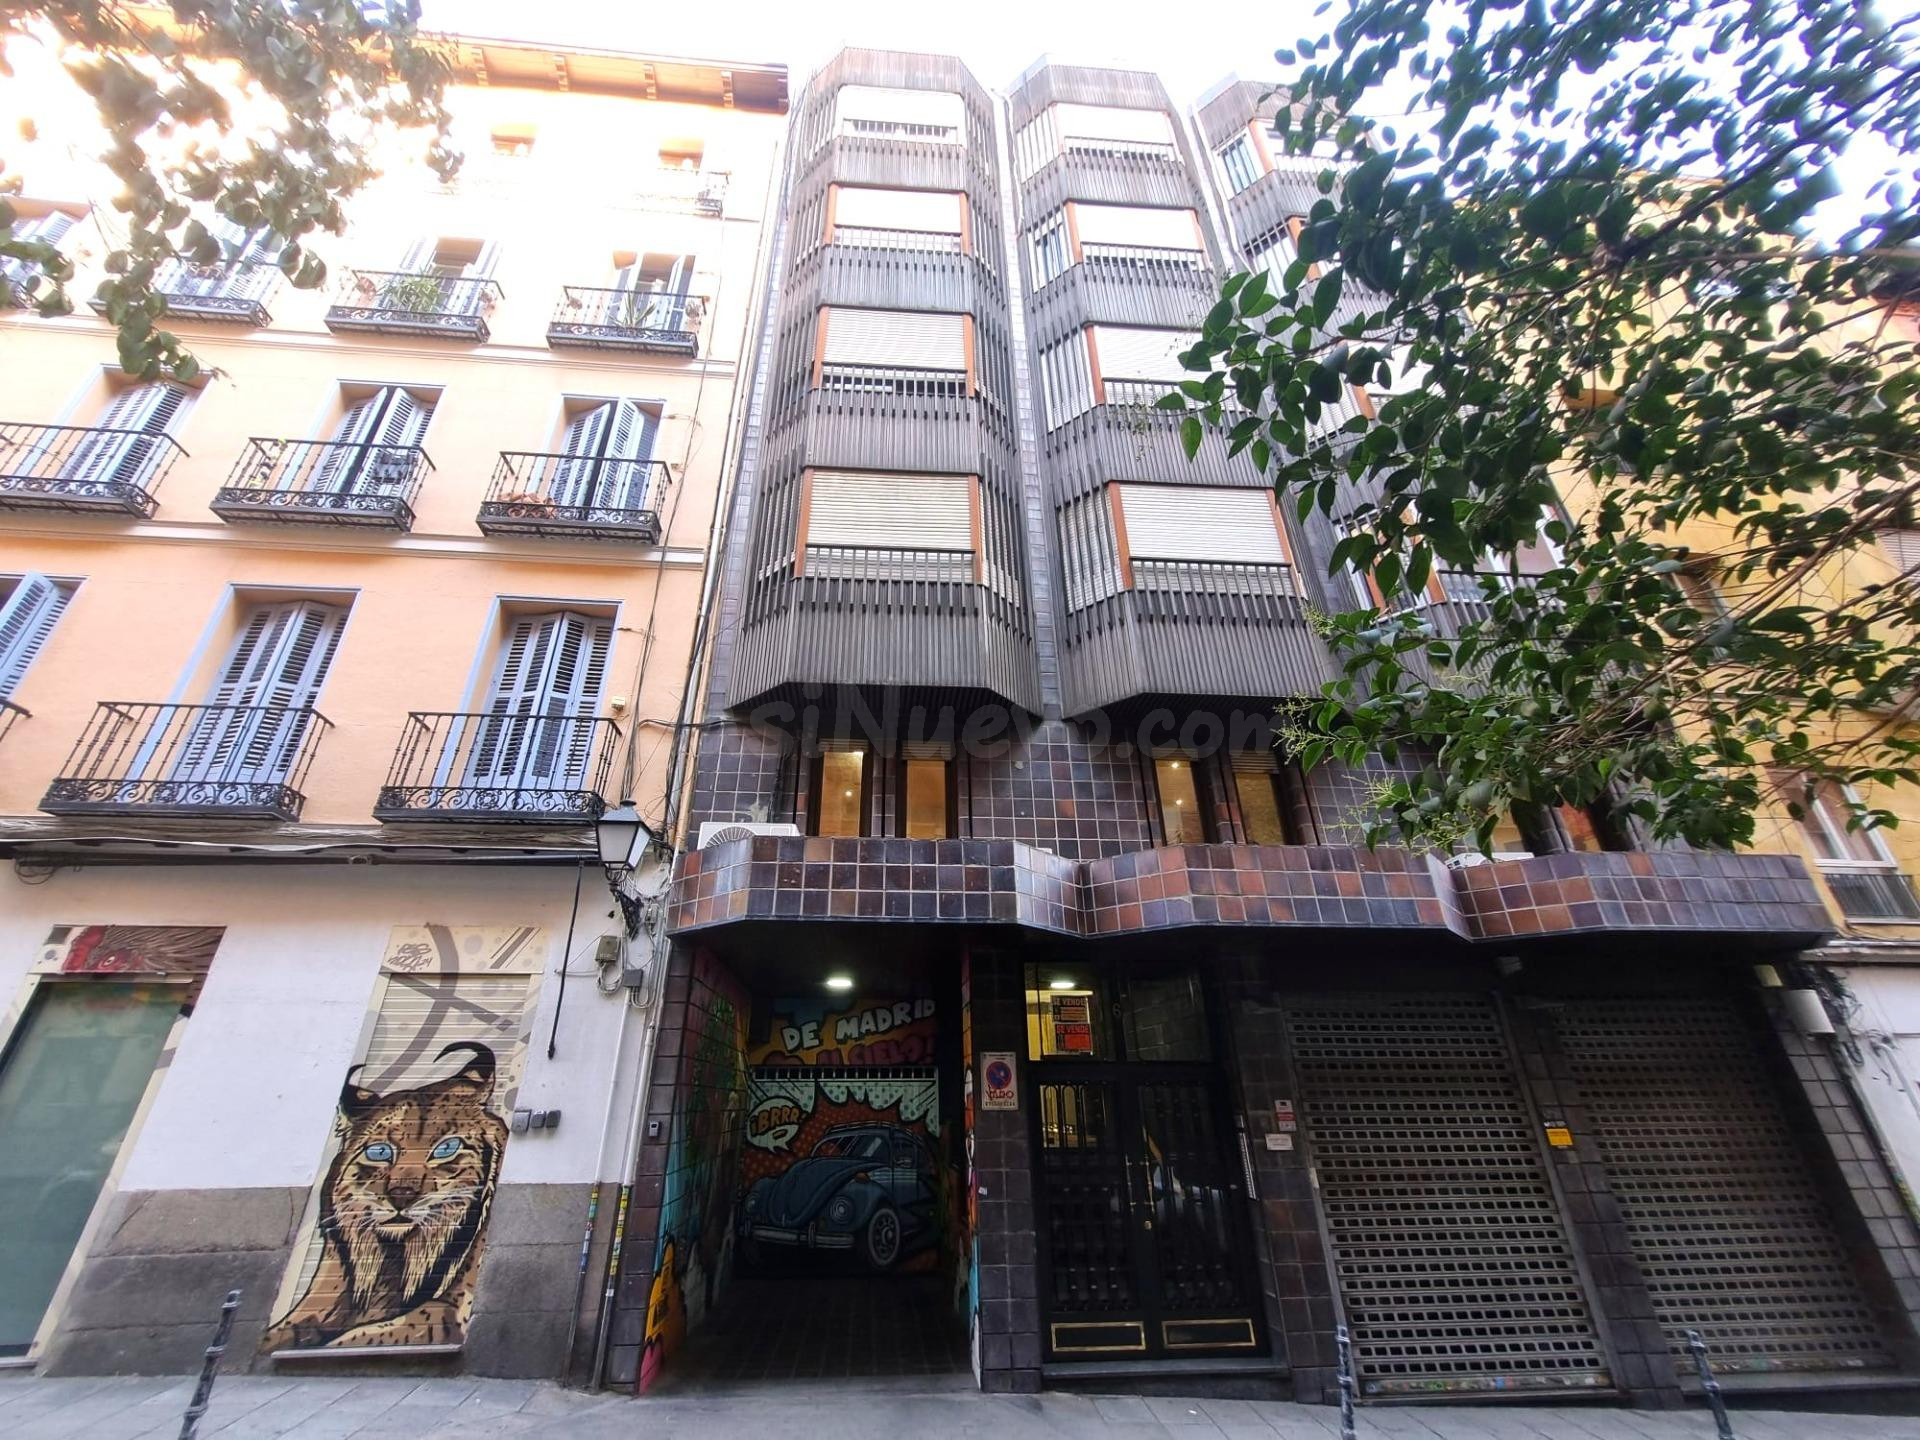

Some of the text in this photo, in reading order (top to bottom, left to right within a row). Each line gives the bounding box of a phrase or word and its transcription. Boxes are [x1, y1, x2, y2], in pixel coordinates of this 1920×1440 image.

[1063, 997, 1087, 1006] VENDE
[1112, 1002, 1121, 1018] 6
[781, 999, 936, 1051] DE MADRID
